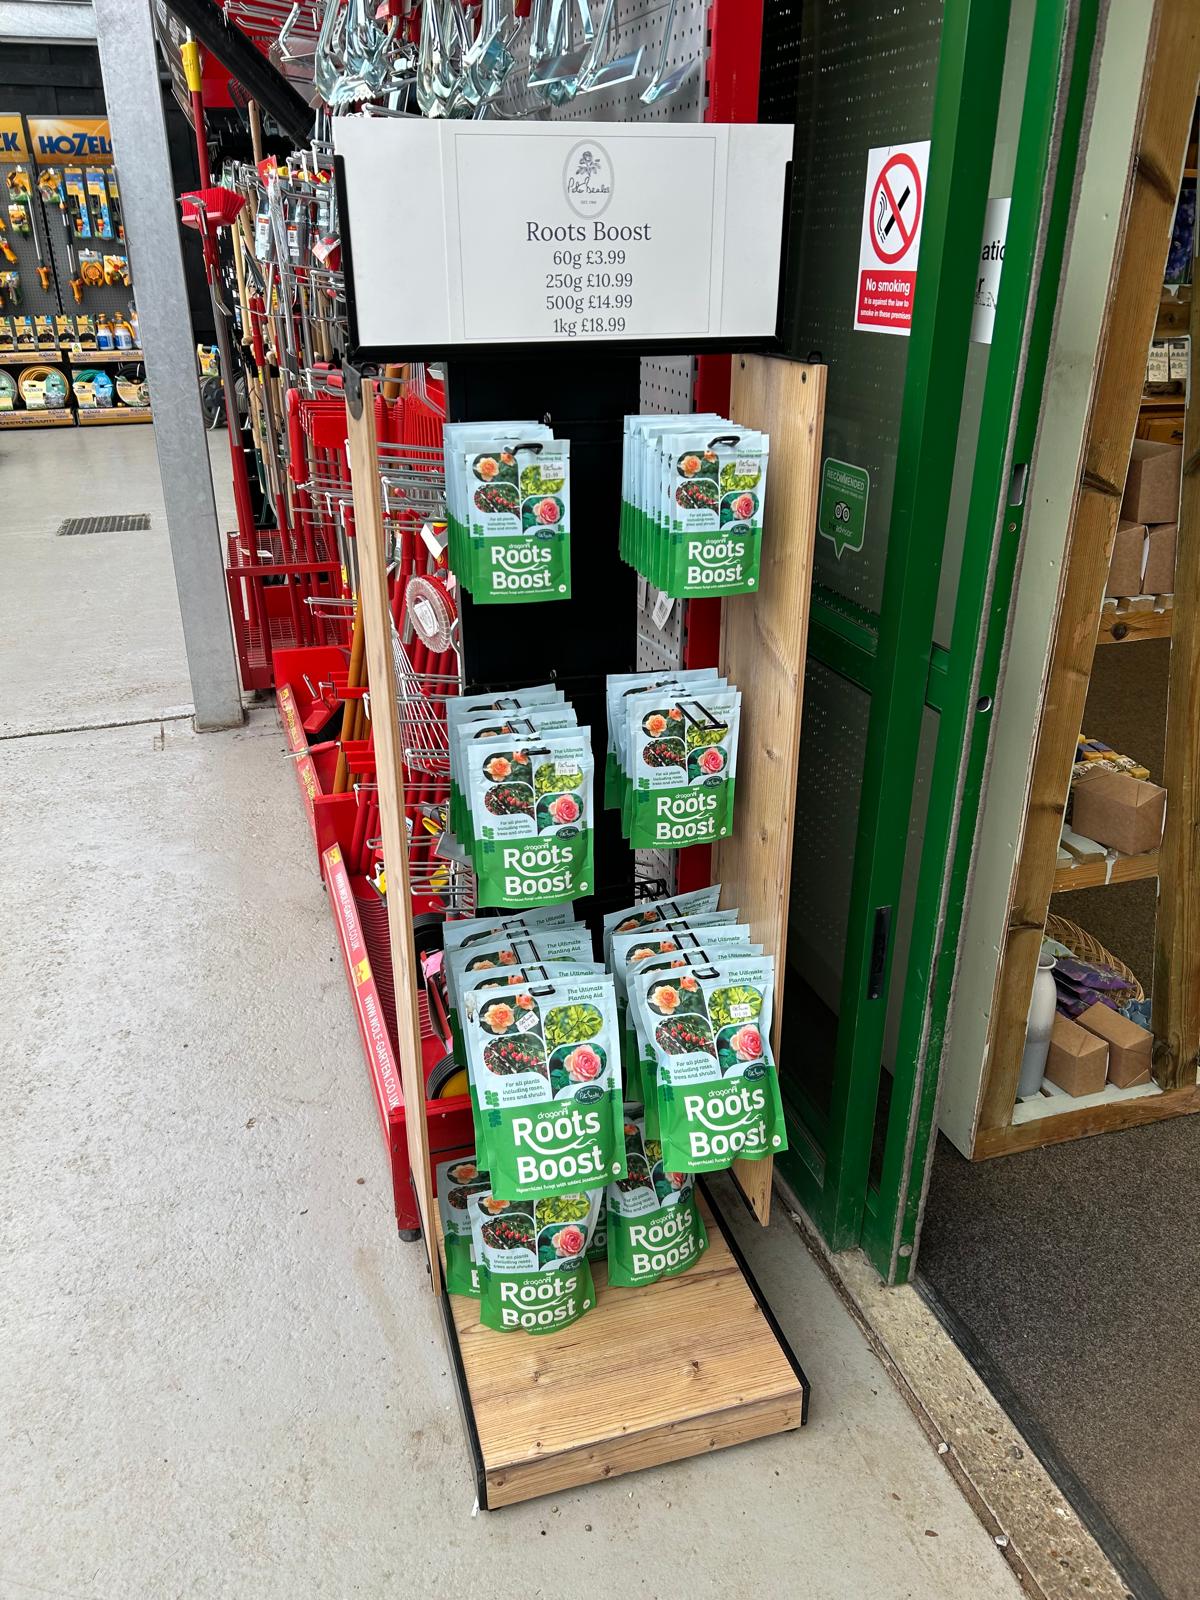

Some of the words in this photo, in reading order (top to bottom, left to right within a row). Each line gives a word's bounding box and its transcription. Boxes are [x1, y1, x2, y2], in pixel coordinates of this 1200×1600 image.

[38, 133, 113, 156] HOZEL
[526, 222, 586, 241] Roots
[593, 222, 652, 241] Boost
[554, 250, 582, 270] 60g
[586, 250, 626, 265] £3.99
[546, 274, 583, 292] 250g
[586, 273, 633, 288] £10.99
[866, 278, 876, 292] No
[878, 280, 910, 296] smoking
[546, 296, 584, 314] 500g
[588, 294, 633, 309] £14.99
[554, 318, 577, 337] 1kg
[581, 317, 626, 332] £18.99
[826, 470, 865, 491] RECOMMENDED
[491, 545, 552, 572] Roots
[688, 540, 745, 567] Roots
[492, 570, 552, 589] Boost
[688, 564, 743, 584] Boost
[656, 793, 717, 822] Roots
[656, 817, 715, 839] Boost
[504, 845, 573, 876] Roots
[505, 871, 573, 896] Boost
[568, 994, 592, 1002] Planting
[364, 994, 400, 1110] WWW.WOLF-GARTEN.CO.UK
[684, 1088, 765, 1131] Roots
[512, 1110, 600, 1155] Roots
[689, 1120, 766, 1157] Boost
[517, 1145, 604, 1184] Boost
[630, 1208, 693, 1251] Roots
[633, 1234, 695, 1274] Boost
[500, 1277, 577, 1310] Roots
[502, 1298, 576, 1327] Boost
